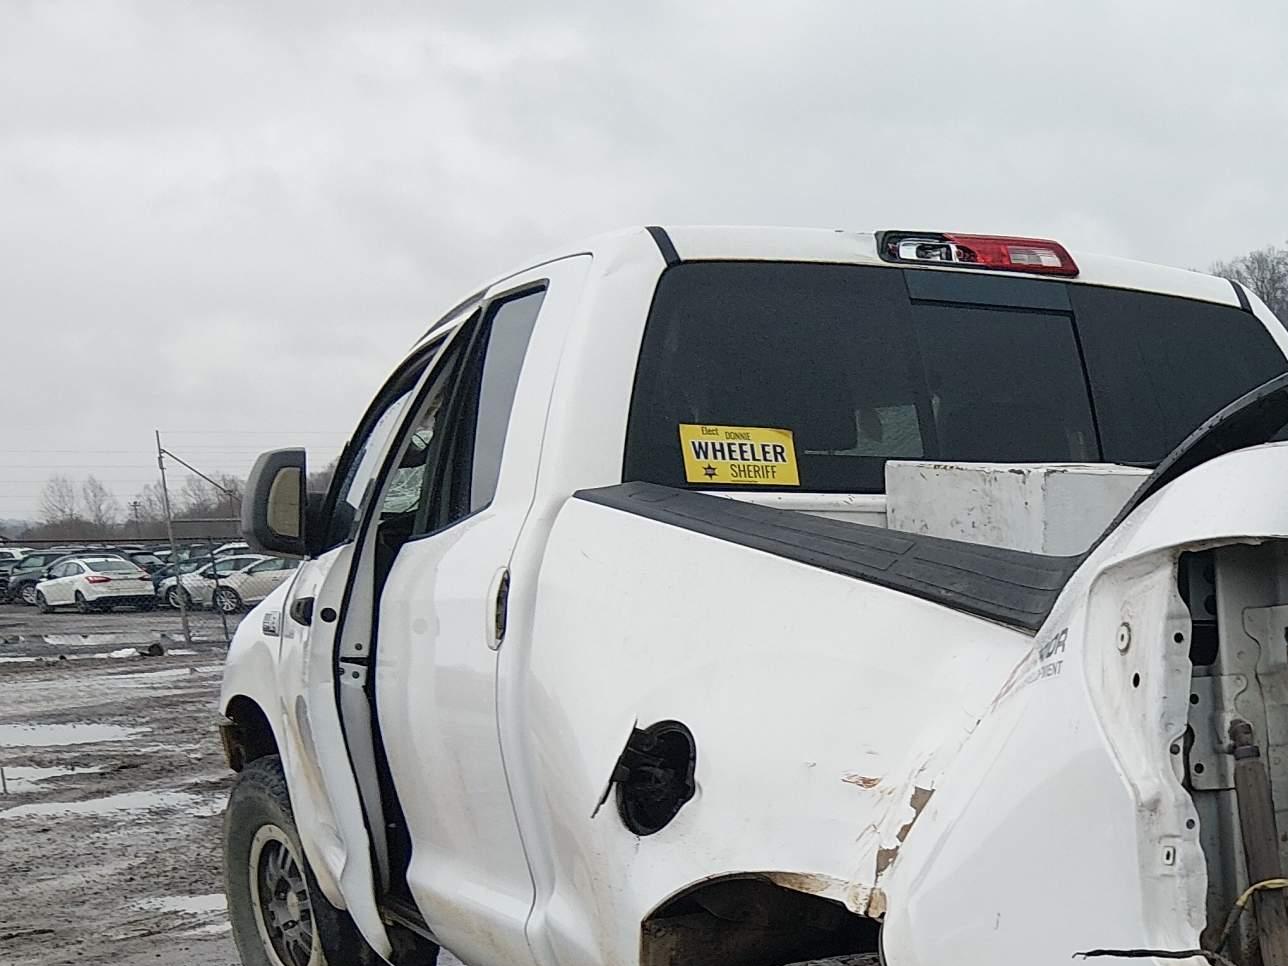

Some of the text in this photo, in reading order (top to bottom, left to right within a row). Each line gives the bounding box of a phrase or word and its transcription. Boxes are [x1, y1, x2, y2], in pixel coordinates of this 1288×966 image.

[701, 426, 751, 441] Elect DONNIE
[691, 441, 787, 463] WHEELER
[730, 464, 777, 479] SHERIFF
